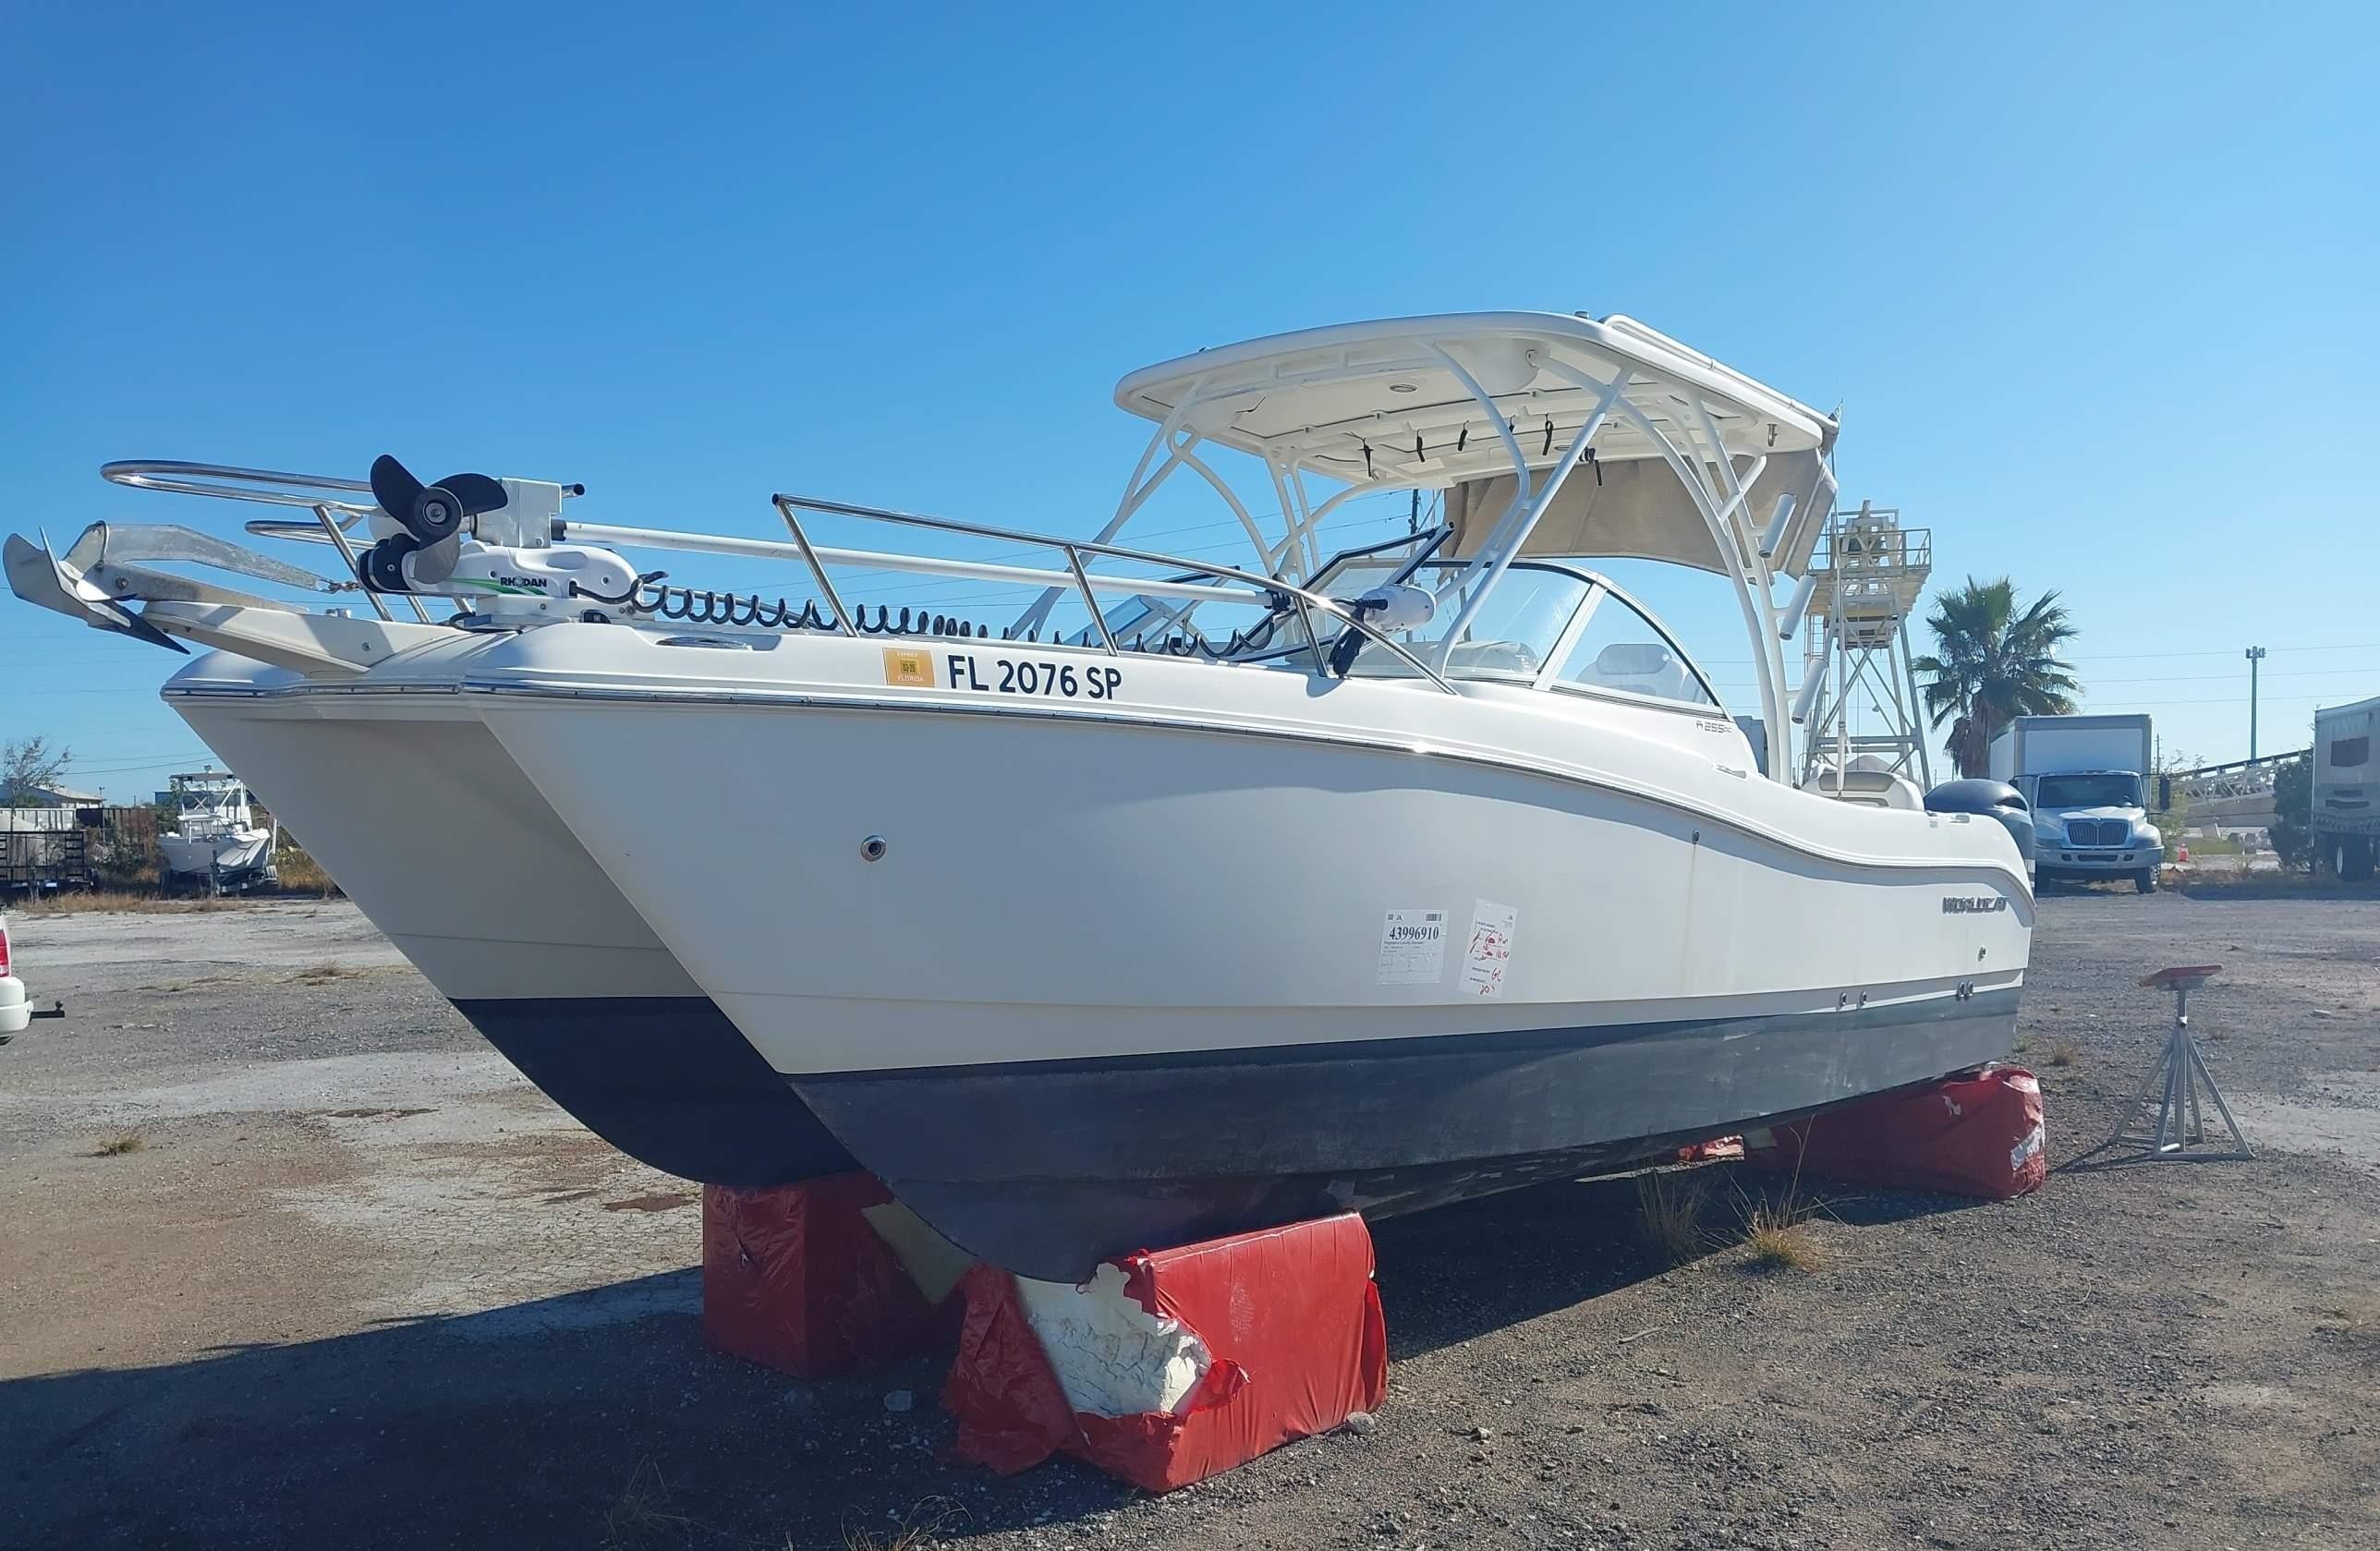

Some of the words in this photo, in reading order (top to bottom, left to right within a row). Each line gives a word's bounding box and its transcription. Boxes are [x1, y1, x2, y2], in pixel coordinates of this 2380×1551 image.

[500, 576, 547, 588] RHODAN
[947, 654, 990, 692] FL
[997, 660, 1078, 698] 2076
[1086, 666, 1123, 700] SP
[1389, 926, 1439, 940] 43996910
